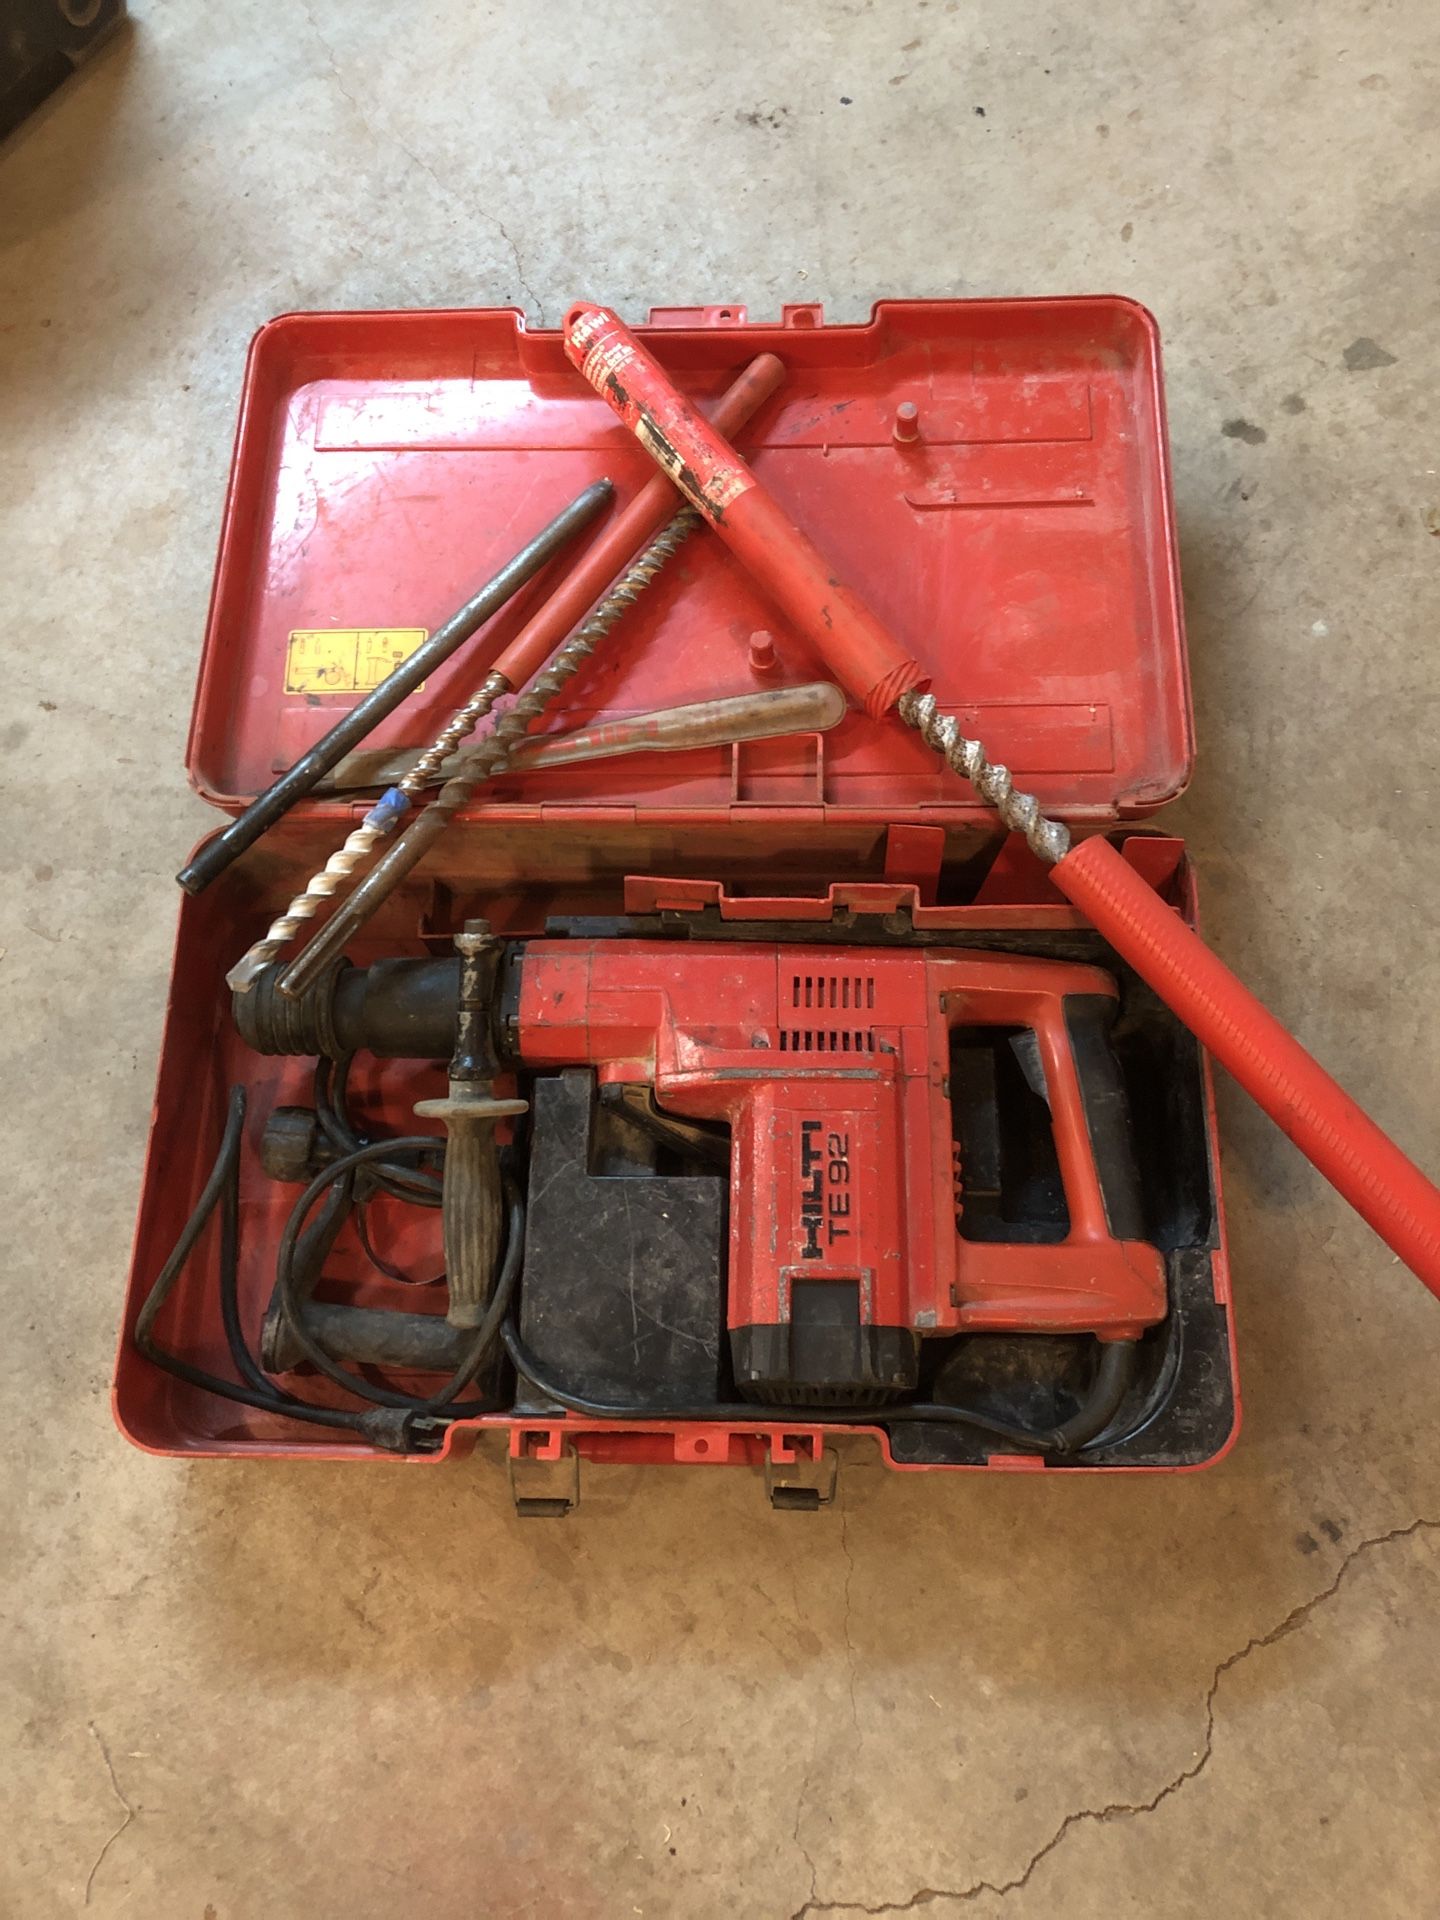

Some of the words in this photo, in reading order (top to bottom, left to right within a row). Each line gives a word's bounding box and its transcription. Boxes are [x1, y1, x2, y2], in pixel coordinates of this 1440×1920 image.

[828, 1131, 850, 1184] 92
[801, 1120, 824, 1260] HILTI
[828, 1192, 850, 1246] TE
